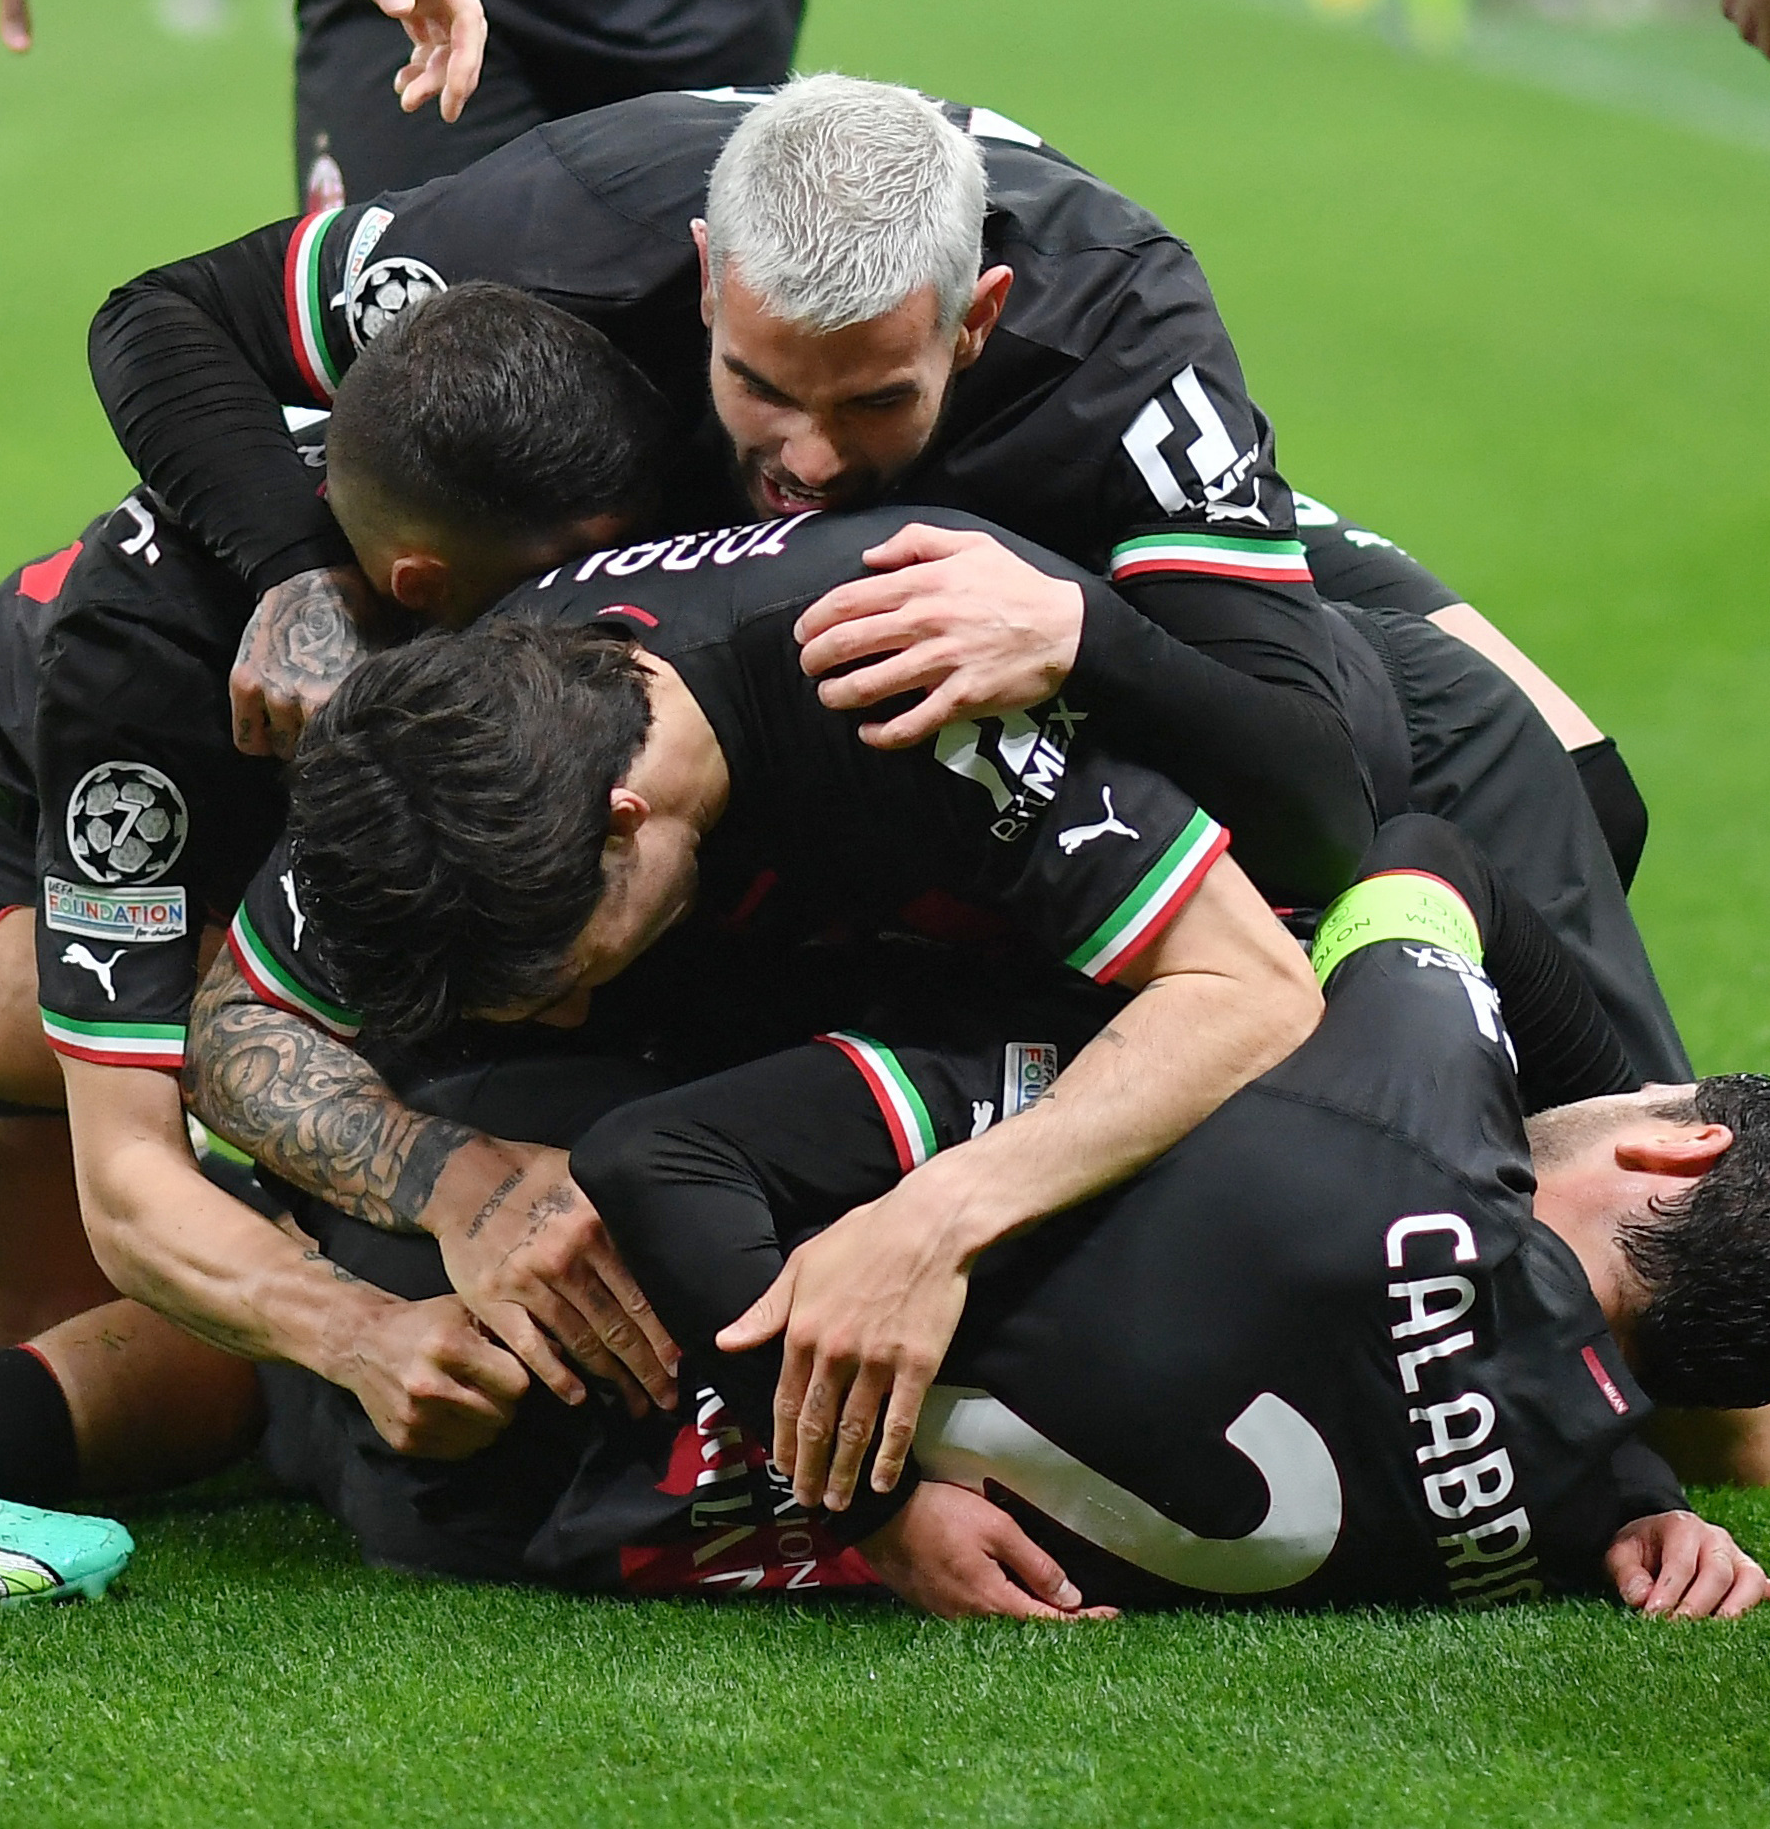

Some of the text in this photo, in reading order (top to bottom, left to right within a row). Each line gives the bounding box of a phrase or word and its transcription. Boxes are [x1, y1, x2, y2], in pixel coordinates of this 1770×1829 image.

[989, 697, 1089, 843] BitMEX
[47, 880, 74, 895] UEFA
[48, 894, 183, 924] FOUNDATION
[1336, 917, 1371, 943] NO
[465, 1167, 527, 1241] IMPOSSIBLE
[912, 1385, 1343, 1595] 2
